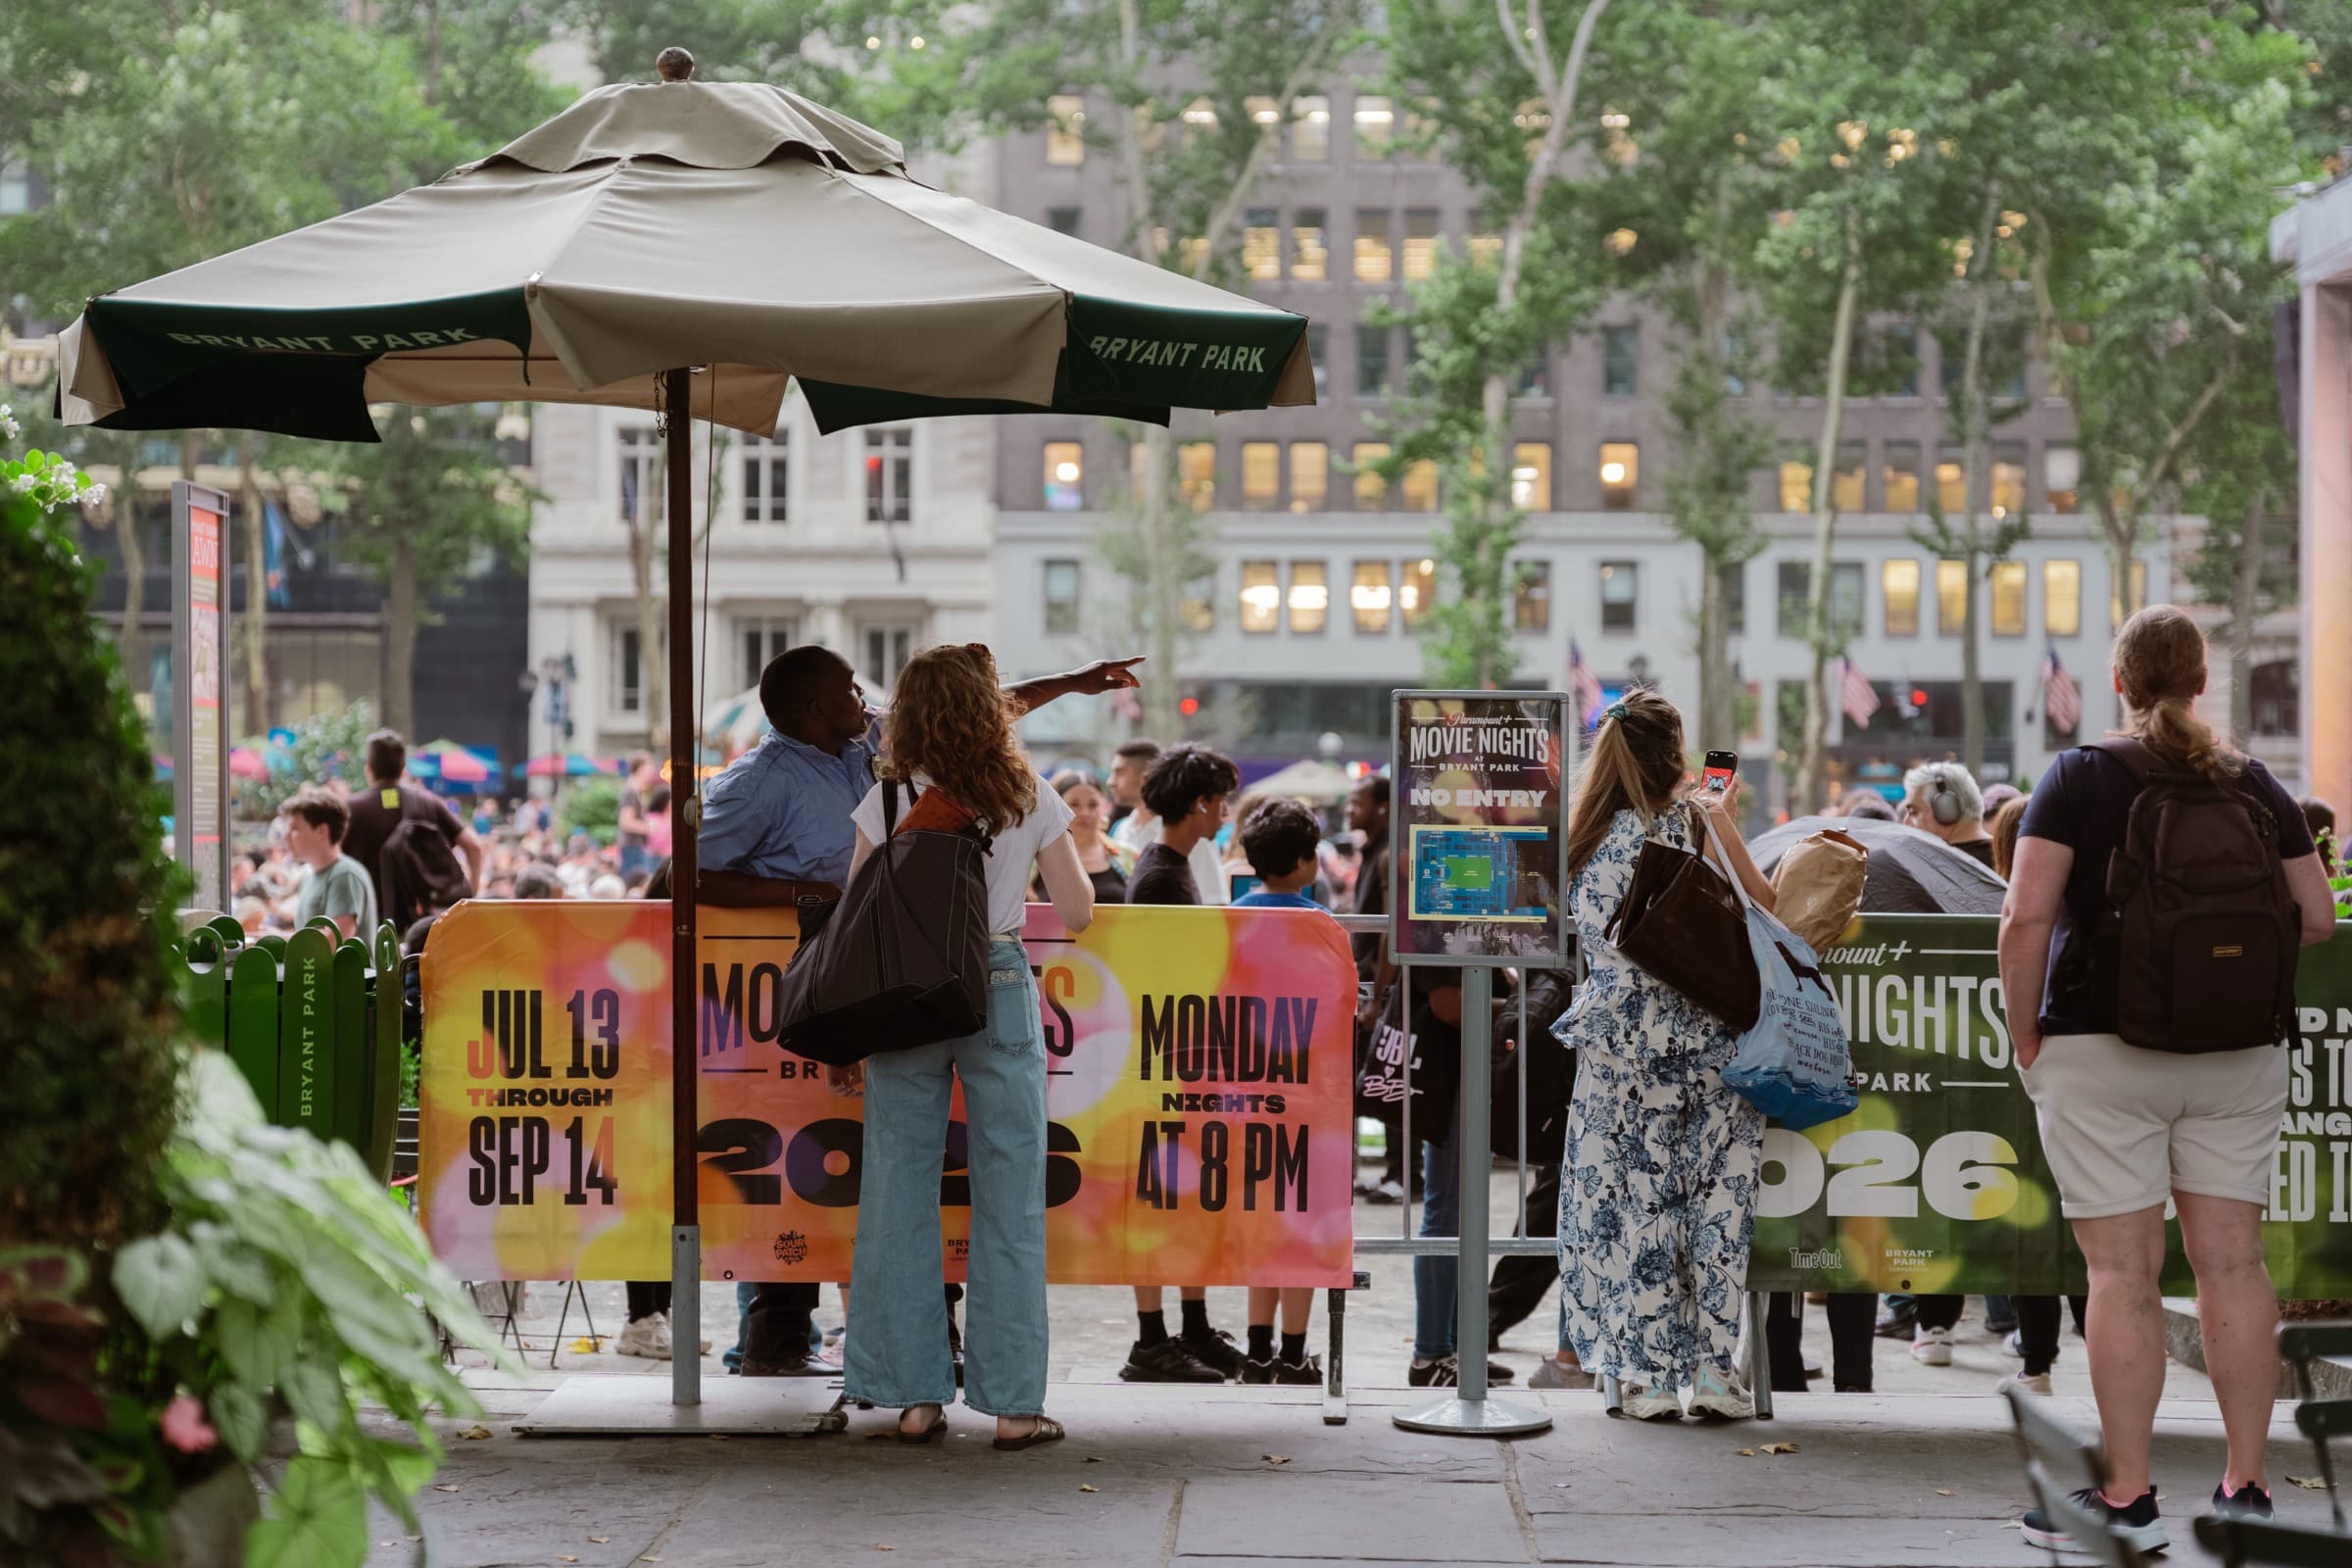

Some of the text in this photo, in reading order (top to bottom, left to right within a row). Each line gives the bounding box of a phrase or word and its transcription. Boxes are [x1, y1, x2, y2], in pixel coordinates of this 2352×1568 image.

[167, 327, 478, 351] BRYANT PARK
[1090, 336, 1265, 373] BRYANT PARK
[1446, 711, 1512, 727] Paramount+
[1410, 727, 1549, 763] MOVIE NIGHTS
[1439, 763, 1486, 772] BRYANT
[1410, 788, 1547, 807] NO ENTRY
[301, 956, 316, 1117] BRYANT PARK
[467, 990, 552, 1079] JUL
[566, 988, 619, 1079] 13
[1141, 994, 1318, 1085] MONDAY
[1856, 1072, 1933, 1093] PARK
[466, 1088, 613, 1107] THROUGH
[1162, 1093, 1286, 1114] NIGHTS
[468, 1115, 617, 1206] SEP 14
[1136, 1120, 1309, 1212] AT 8 PM
[1755, 1128, 2020, 1221] 026
[775, 1247, 808, 1258] PATCH
[776, 1238, 805, 1249] SOUR
[1885, 1250, 1935, 1258] BRYANT
[1893, 1257, 1927, 1266] PARK
